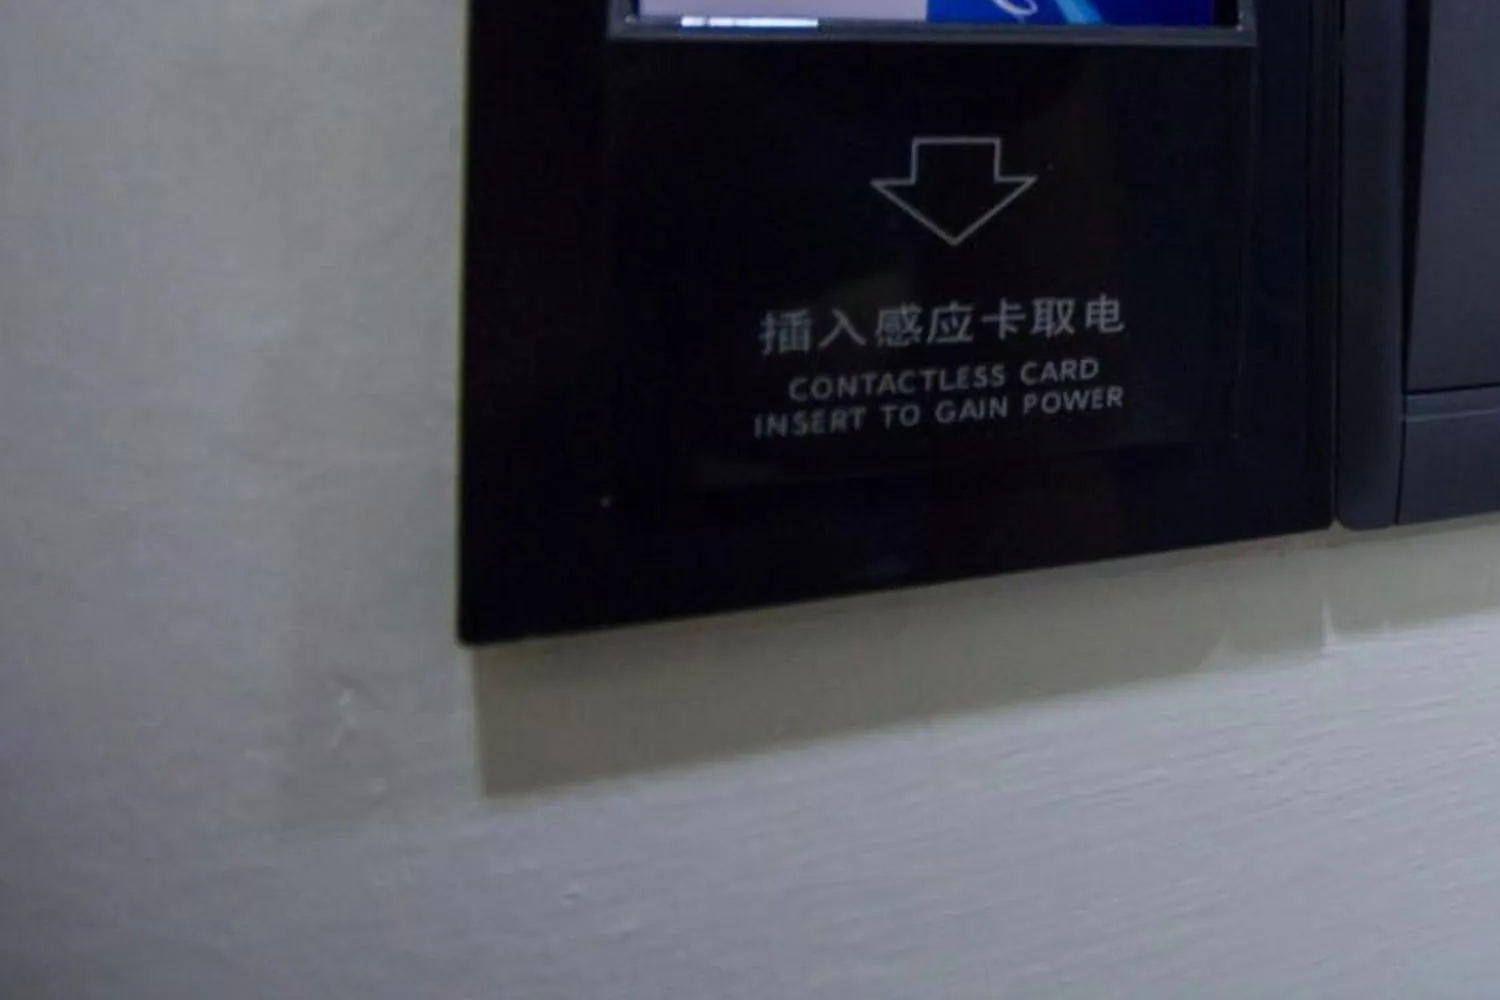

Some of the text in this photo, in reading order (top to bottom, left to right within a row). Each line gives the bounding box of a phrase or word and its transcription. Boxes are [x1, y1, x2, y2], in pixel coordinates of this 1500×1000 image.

[759, 295, 1126, 354] 插入感应卡取电
[788, 357, 1100, 402] CONTACTLESS CARD
[754, 386, 1125, 439] INSERT TO GAIN POWER
